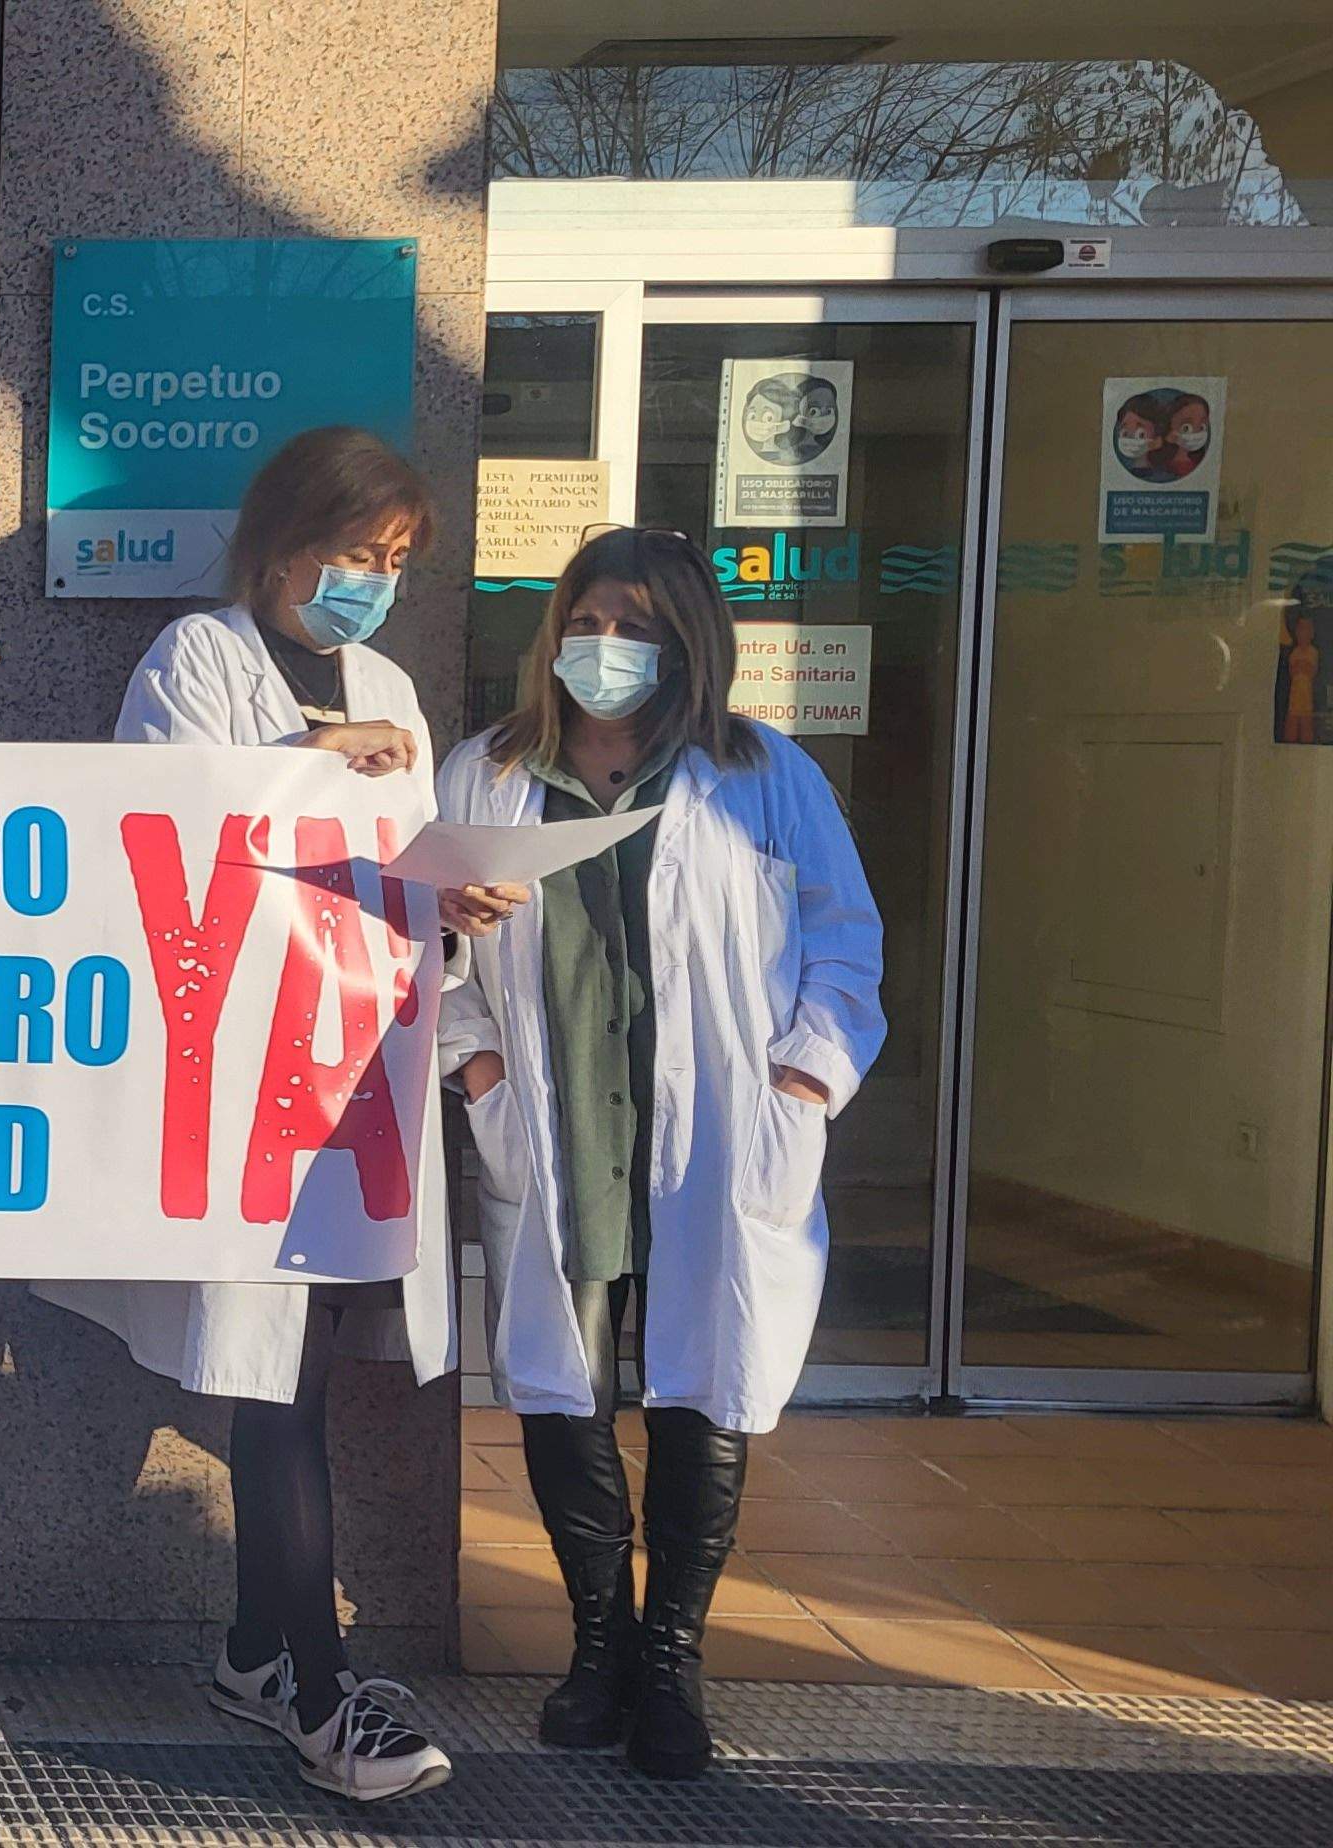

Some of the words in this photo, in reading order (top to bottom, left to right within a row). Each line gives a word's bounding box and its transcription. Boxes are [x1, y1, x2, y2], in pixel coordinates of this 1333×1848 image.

[83, 293, 134, 317] C.S.
[80, 363, 282, 406] Perpetuo
[79, 412, 260, 449] Socorro
[530, 472, 599, 482] PERMITIDO
[741, 479, 763, 488] USO
[765, 479, 832, 488] OBLIGATORIO
[527, 486, 534, 495] A
[741, 490, 757, 499] DE
[760, 490, 831, 499] MASCARILLA
[504, 499, 572, 508] SANITARIO
[577, 499, 598, 508] SIN
[1113, 496, 1134, 505] USO
[1137, 496, 1203, 505] OBLIGATORIO
[477, 511, 534, 520] CARILLA.
[1113, 507, 1127, 516] DE
[1133, 507, 1201, 516] MASCARILLA
[484, 524, 499, 534] SE
[514, 525, 581, 534] SUMINISTR
[76, 529, 174, 563] salud
[477, 538, 537, 547] CARILLAS
[551, 538, 559, 547] A
[712, 532, 860, 583] salud
[768, 592, 782, 600] de
[735, 639, 778, 654] ntra
[784, 639, 816, 655] Ud.
[823, 643, 847, 655] en
[770, 666, 856, 682] Sanitaria
[729, 705, 798, 720] OHIBIDO
[803, 705, 862, 720] FUMAR
[120, 812, 419, 1225] YA!
